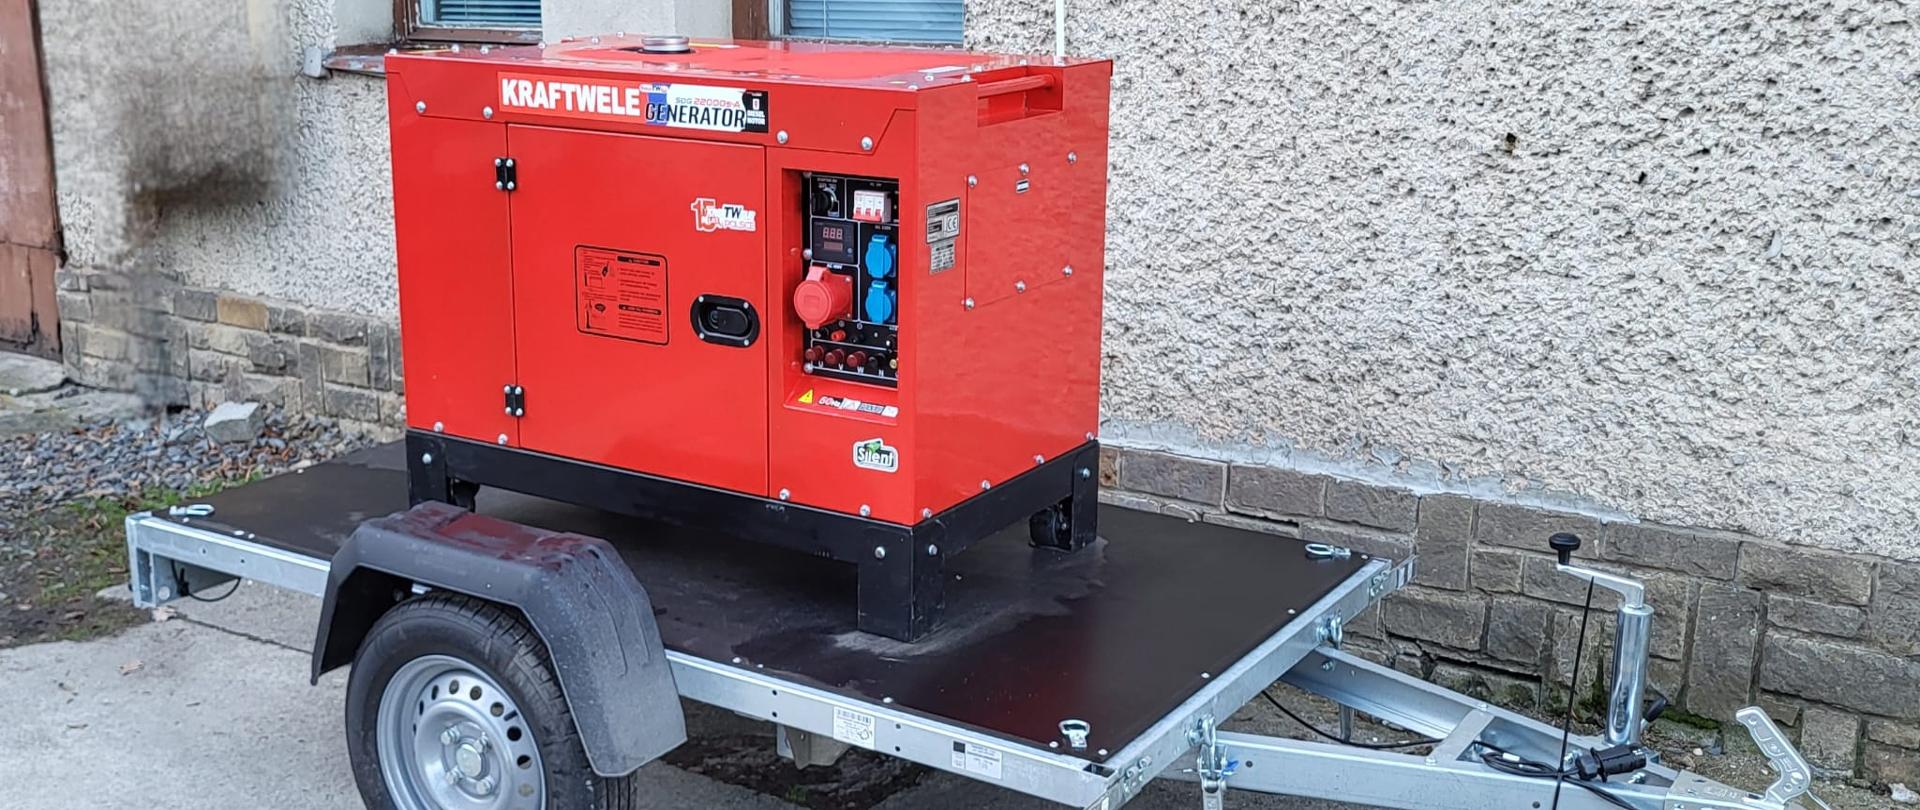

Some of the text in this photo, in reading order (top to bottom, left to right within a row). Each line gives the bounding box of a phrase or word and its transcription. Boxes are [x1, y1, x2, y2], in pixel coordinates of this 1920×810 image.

[501, 78, 640, 116] KRAFTWELE
[645, 102, 745, 128] GENERATOR
[724, 206, 742, 219] TW
[857, 447, 893, 466] Silent
